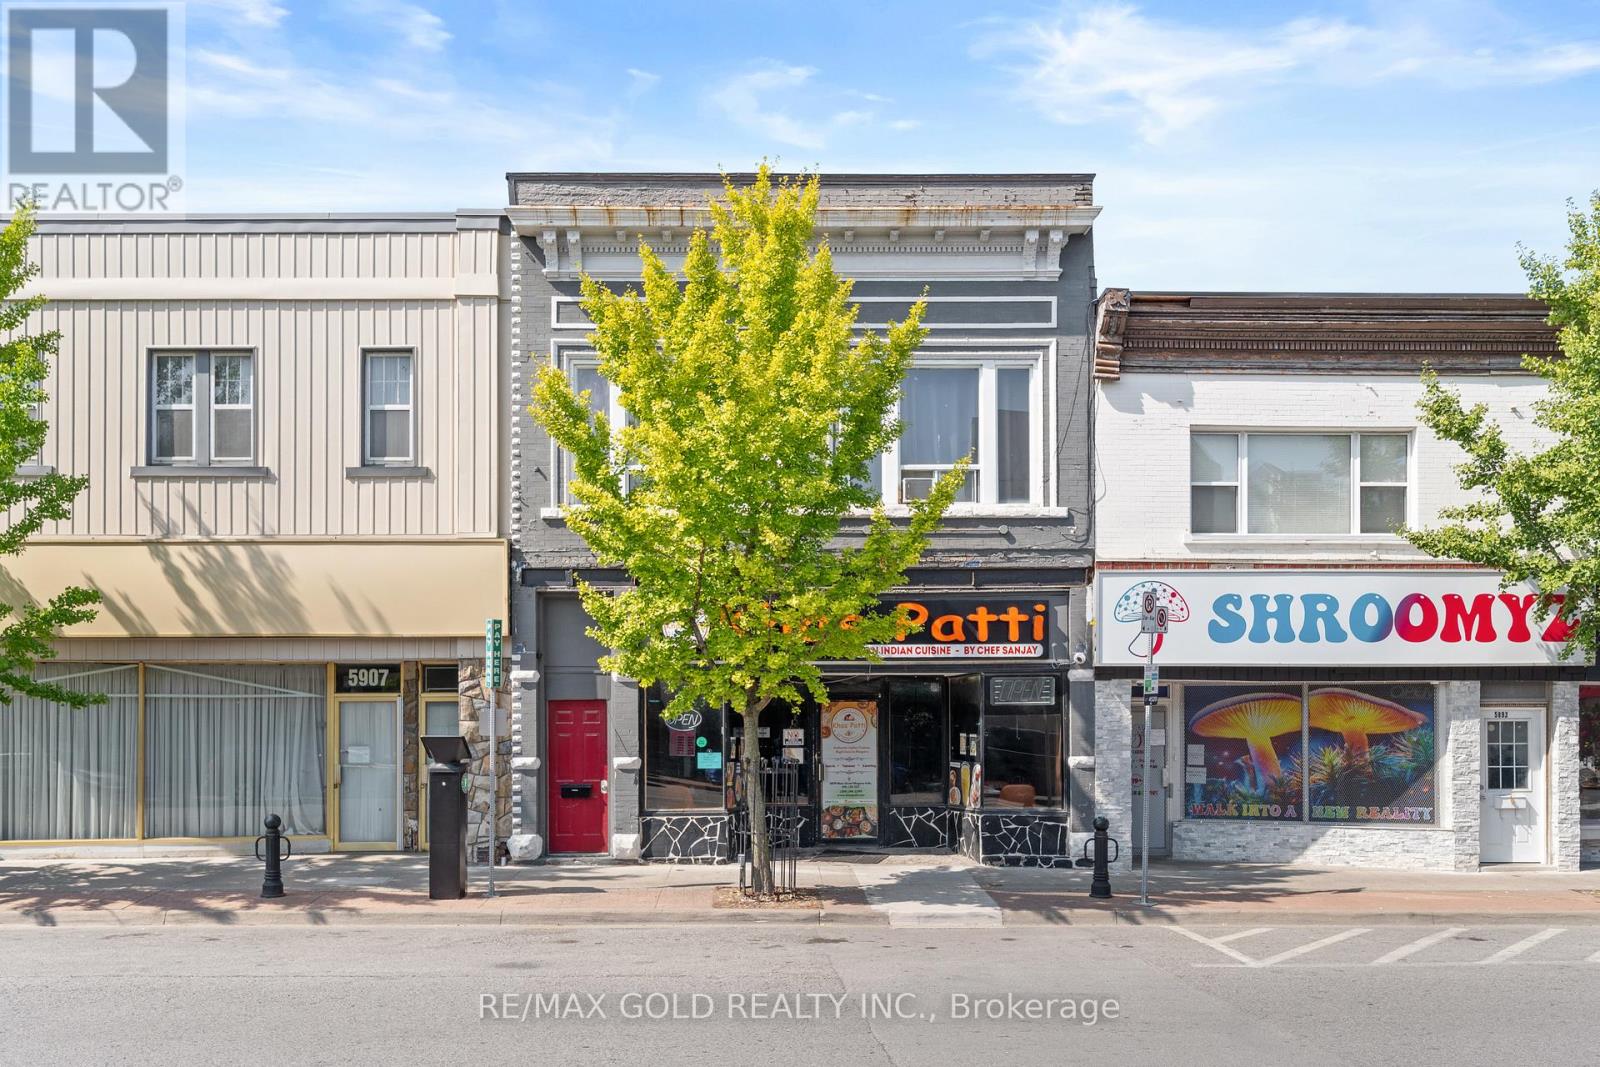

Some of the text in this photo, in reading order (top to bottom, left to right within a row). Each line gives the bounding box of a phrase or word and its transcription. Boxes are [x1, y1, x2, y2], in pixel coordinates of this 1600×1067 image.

[895, 602, 1046, 642] Patti
[914, 645, 951, 655] CUISINE
[964, 645, 976, 655] BY
[977, 645, 1000, 655] CHEF
[1002, 645, 1038, 655] SANJAY
[348, 668, 389, 687] 5907
[998, 678, 1046, 702] OPEN
[1191, 800, 1433, 820] WALK INTO A NEW REALITY
